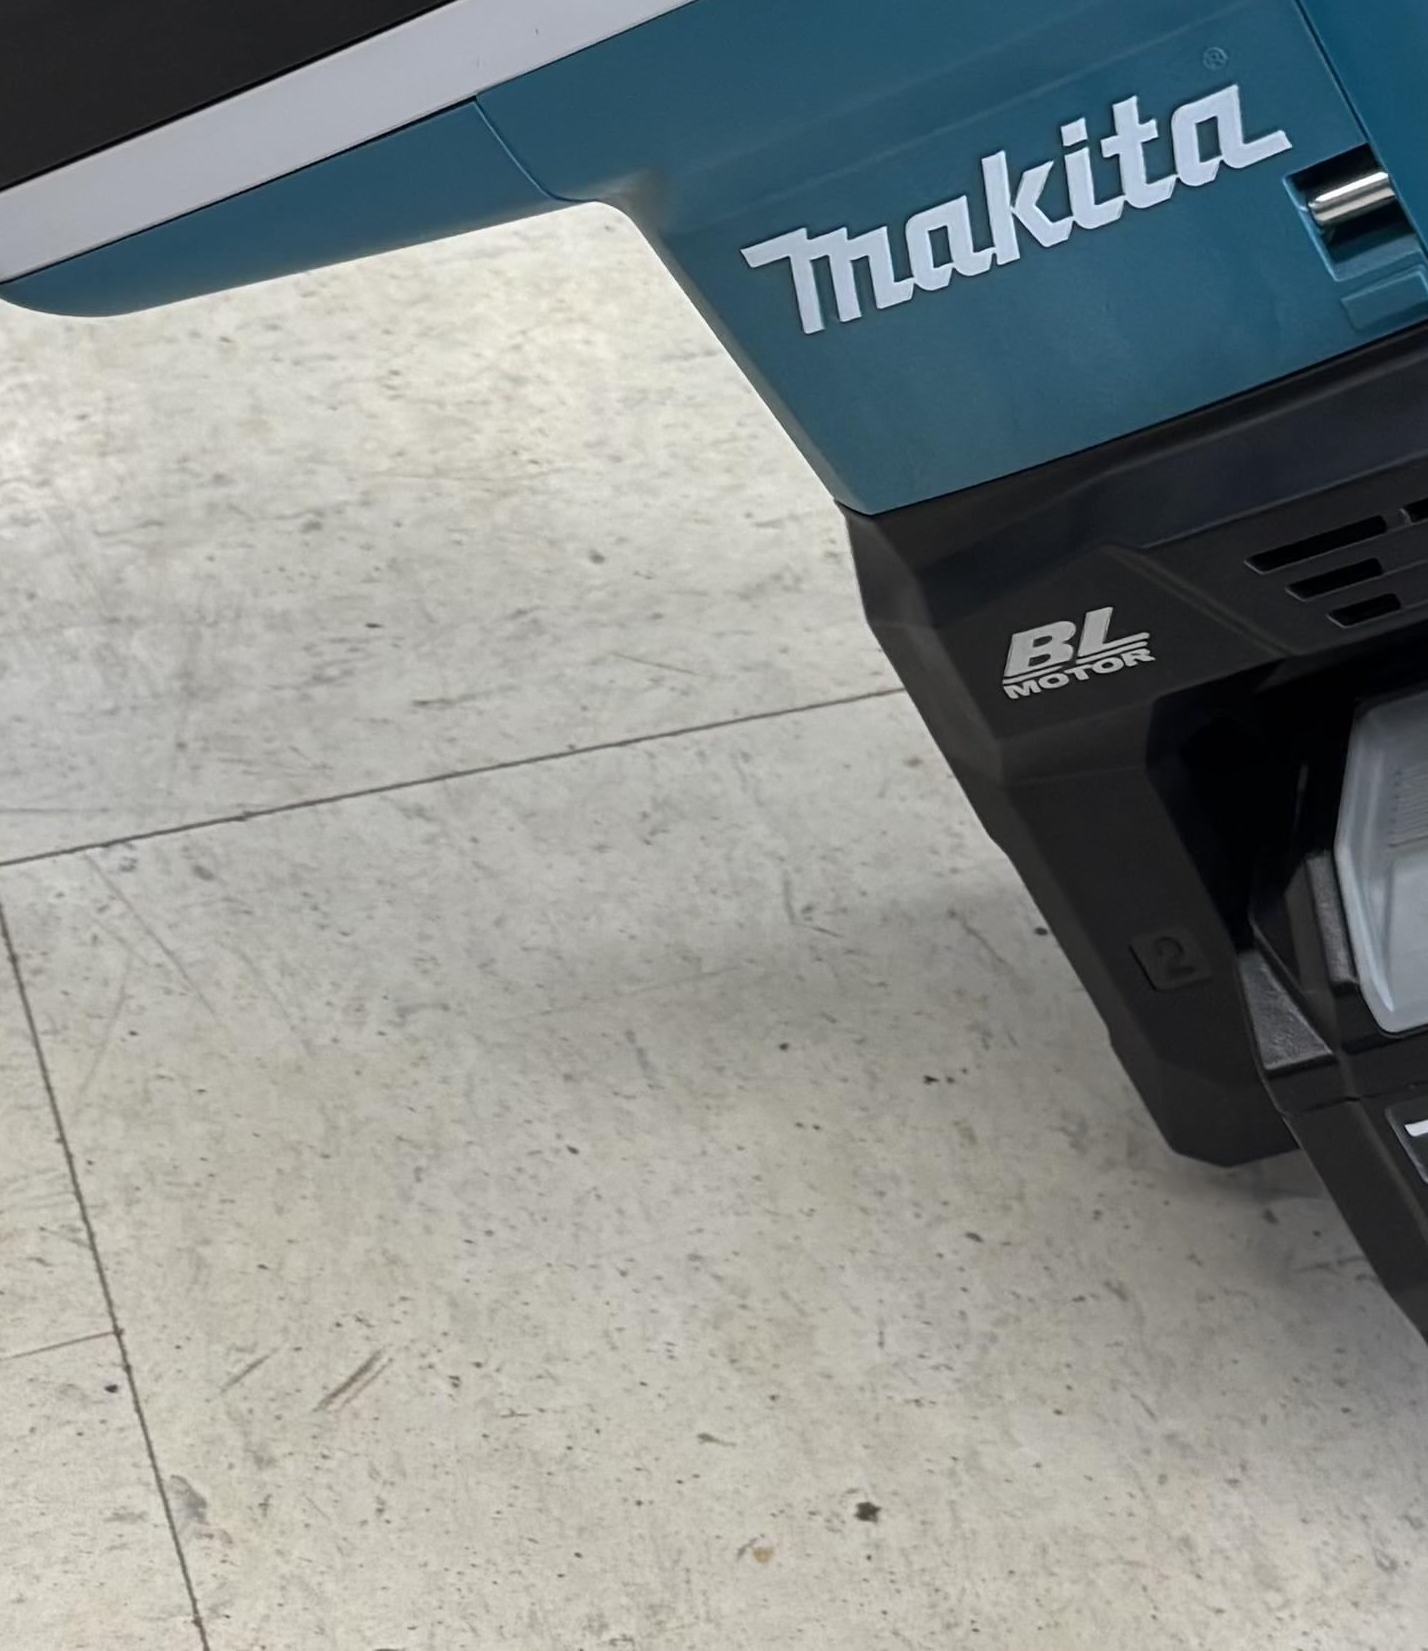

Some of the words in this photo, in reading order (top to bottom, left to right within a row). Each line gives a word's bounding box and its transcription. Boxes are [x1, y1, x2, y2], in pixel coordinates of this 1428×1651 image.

[1003, 607, 1151, 679] BL
[1002, 648, 1156, 699] MOTOR
[1153, 936, 1197, 981] 2
